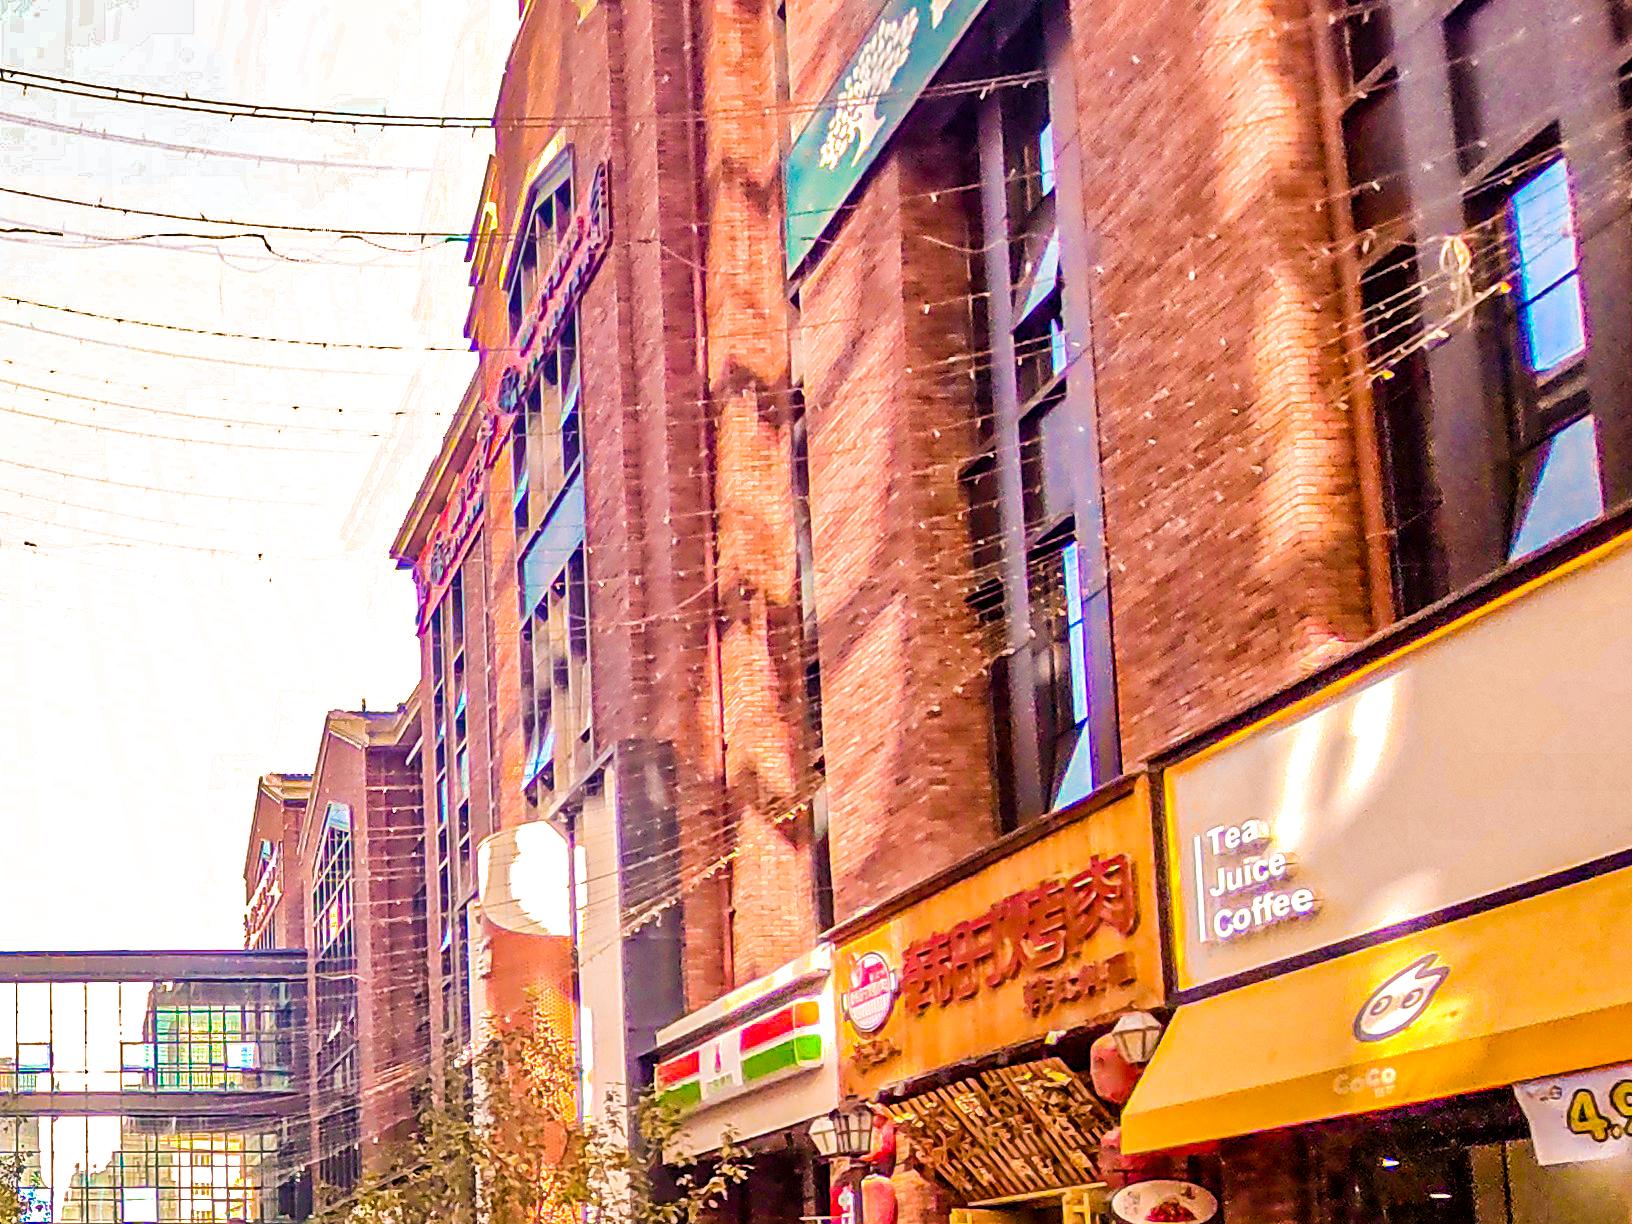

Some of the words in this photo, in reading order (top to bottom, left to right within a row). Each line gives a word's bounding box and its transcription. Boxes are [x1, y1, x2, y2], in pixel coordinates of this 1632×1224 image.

[1207, 819, 1262, 855] Tea
[1209, 852, 1286, 897] Juice
[1213, 888, 1315, 938] Coffee
[1334, 1067, 1397, 1096] CoCo
